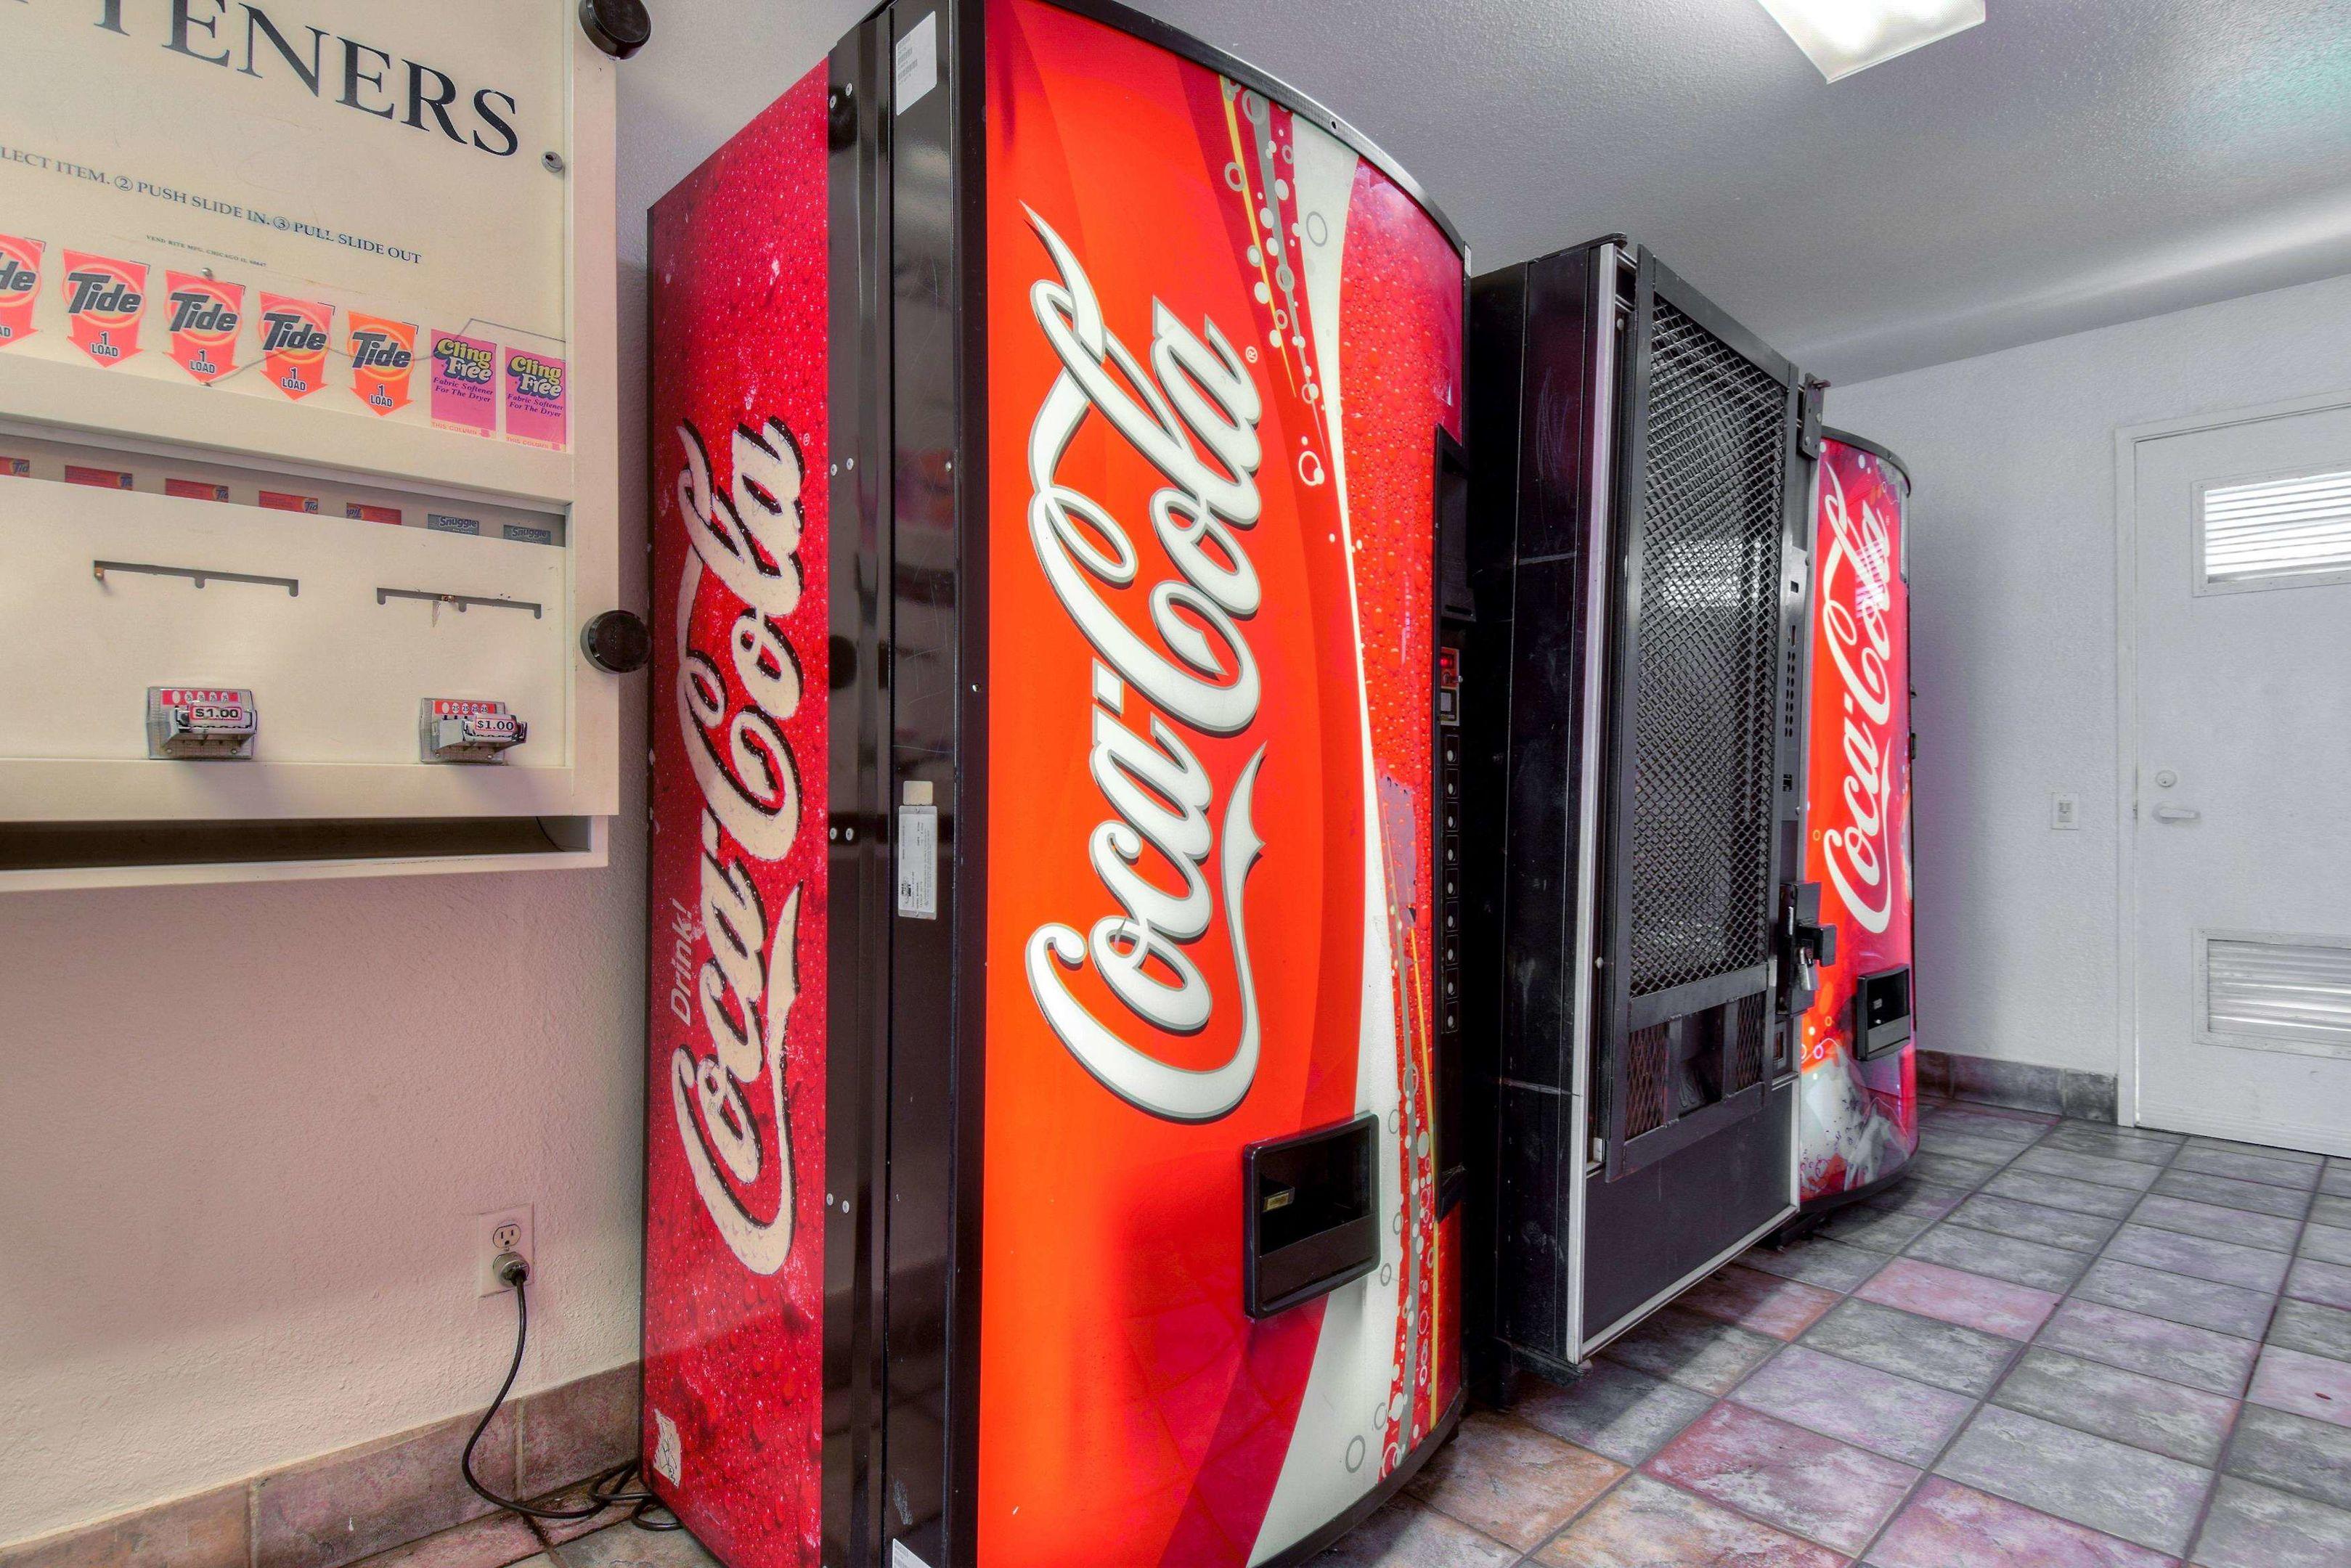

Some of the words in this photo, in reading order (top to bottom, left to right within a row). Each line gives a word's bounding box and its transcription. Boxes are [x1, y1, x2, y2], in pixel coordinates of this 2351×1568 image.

[57, 161, 110, 184] ITEM.
[138, 182, 187, 203] PUSH
[192, 196, 242, 218] SLIDE
[247, 210, 269, 225] IN.
[294, 222, 334, 241] PULL
[338, 234, 383, 254] SLIDE
[388, 247, 422, 264] OUT
[206, 250, 239, 261] CHICAGO
[68, 272, 141, 314] Tide
[169, 292, 238, 331] Tide
[100, 332, 107, 345] 1
[262, 312, 327, 351] Tide
[91, 343, 118, 357] LOAD
[199, 350, 205, 362] 1
[351, 332, 412, 369] Tide
[436, 338, 492, 369] Cling
[190, 360, 216, 373] LOAD
[290, 367, 297, 379] 1
[447, 356, 493, 382] Free
[509, 356, 562, 385] Cling
[282, 378, 306, 391] LOAD
[378, 385, 385, 396] 1
[433, 377, 459, 388] Fabric
[462, 383, 494, 396] Softener
[519, 373, 563, 398] Free
[370, 395, 393, 407] LOAD
[435, 385, 449, 393] For
[452, 388, 466, 398] The
[468, 392, 491, 403] Dryer
[508, 393, 531, 404] Fabric
[534, 399, 563, 410] Softener
[524, 404, 538, 413] The
[540, 407, 561, 417] Dryer
[449, 425, 478, 435] COLUMN
[439, 516, 477, 528] Snuggle
[512, 527, 547, 538] Snuggle
[1019, 198, 1267, 1124] Coca-Cola
[1824, 462, 1892, 934] Coca-Cola
[195, 709, 239, 718] $1.00
[477, 719, 514, 731] $1.00
[672, 416, 804, 1275] Coca-Cola
[670, 897, 692, 1026] Drink!
